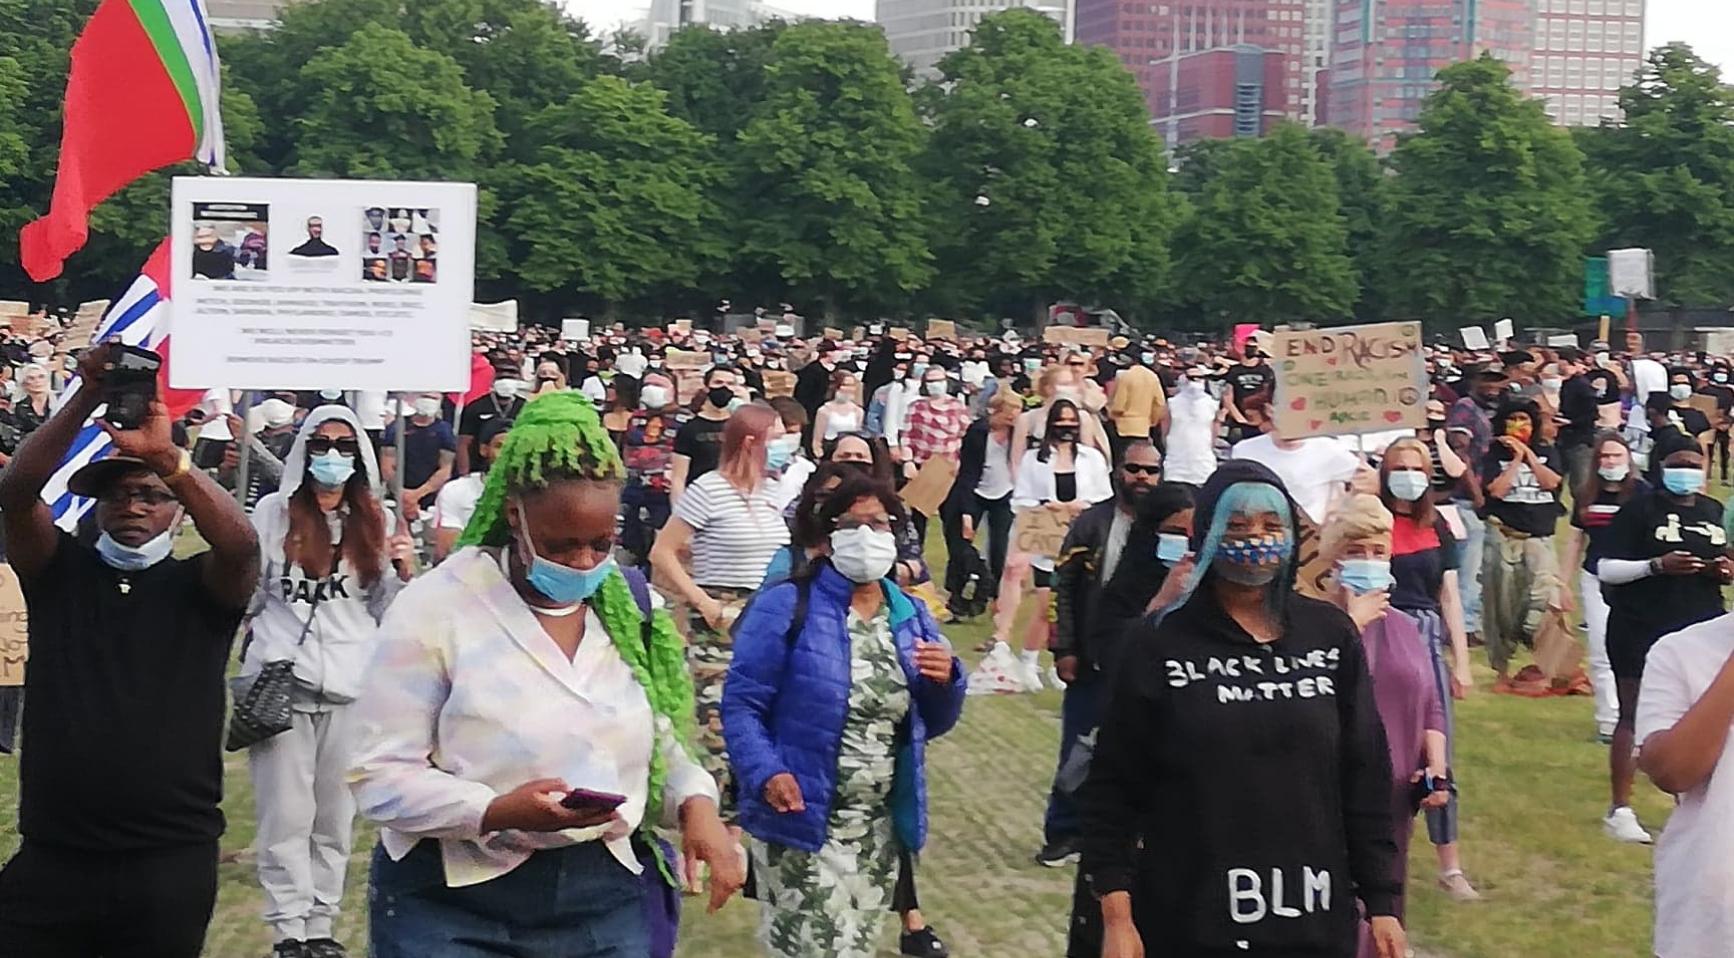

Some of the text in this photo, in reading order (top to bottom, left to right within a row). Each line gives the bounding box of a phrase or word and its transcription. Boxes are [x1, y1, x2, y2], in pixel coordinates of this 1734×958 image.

[1286, 331, 1417, 370] END RACISM
[1165, 647, 1340, 688] BLACK LIVES
[1217, 675, 1336, 704] MATTER
[1227, 865, 1331, 923] BLM
